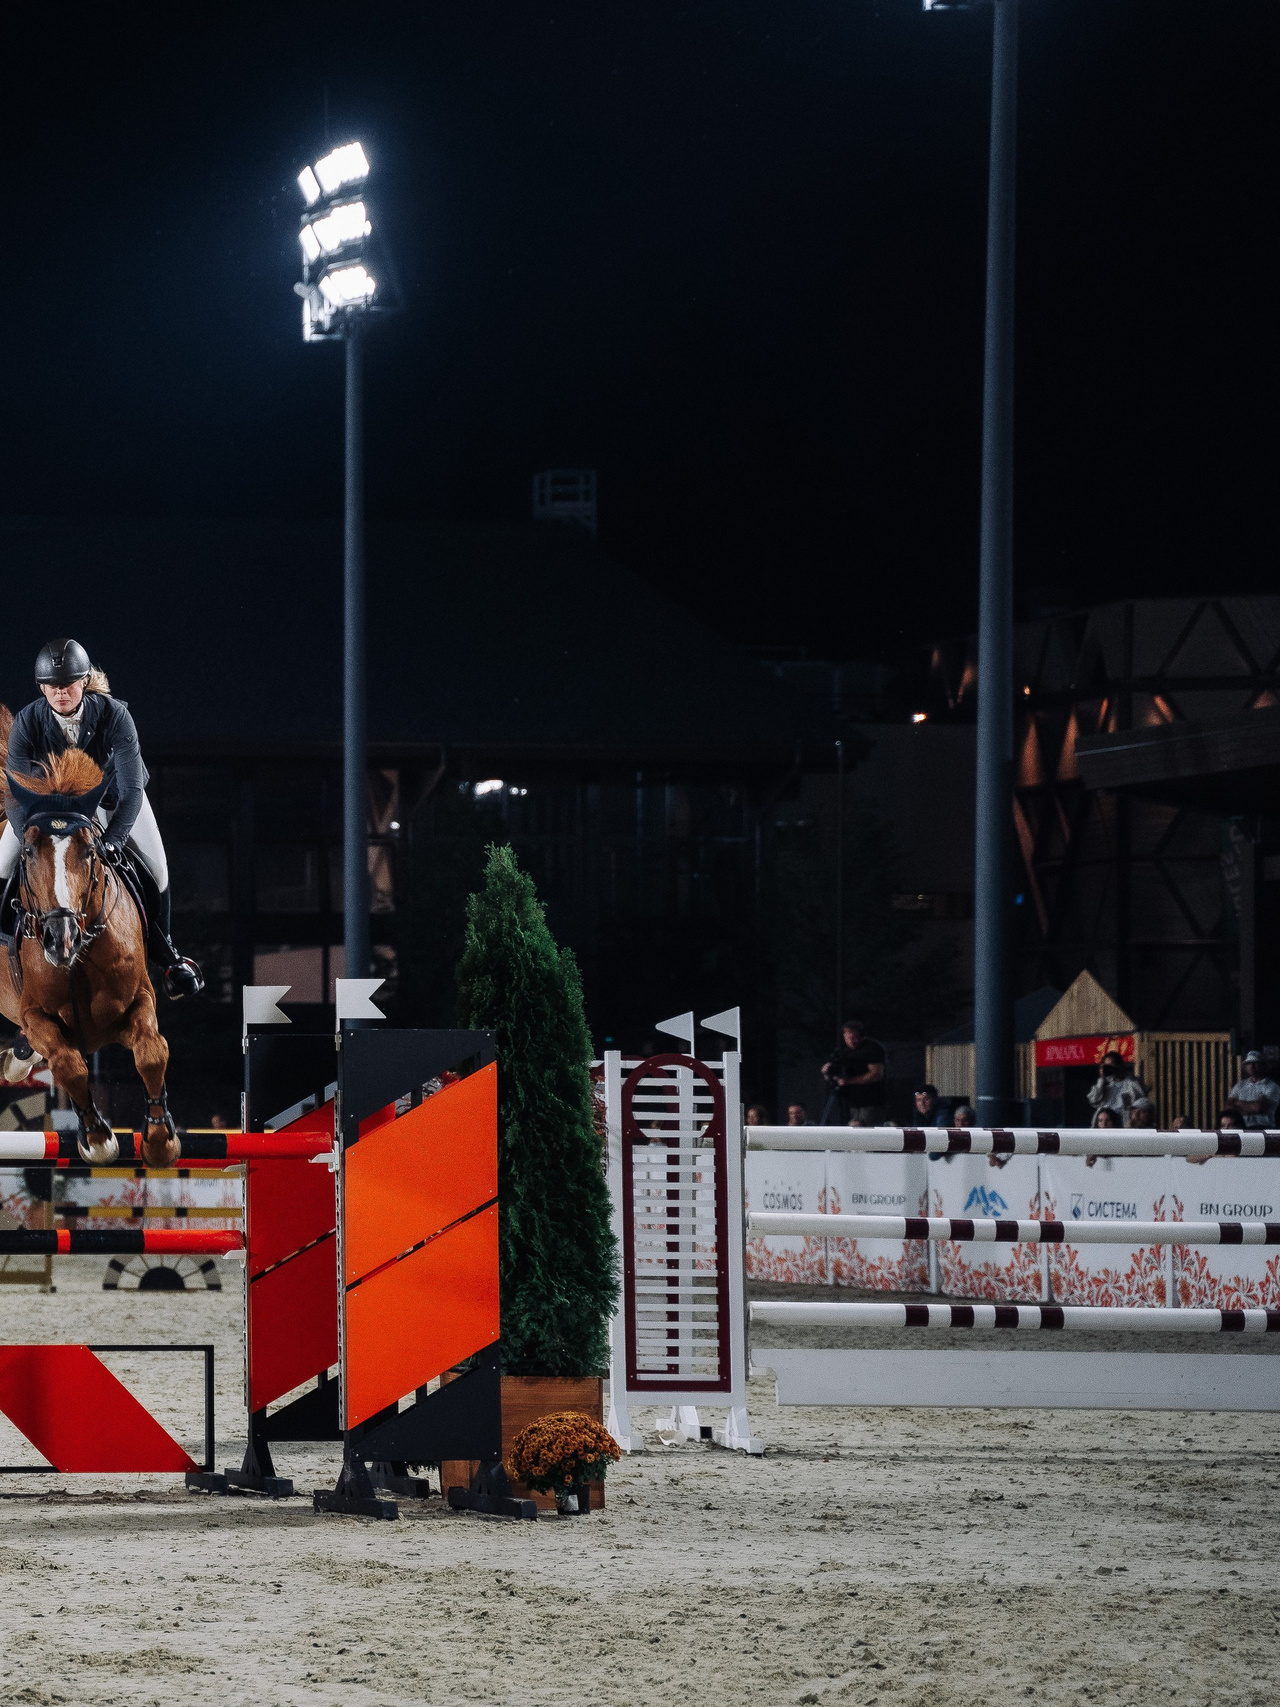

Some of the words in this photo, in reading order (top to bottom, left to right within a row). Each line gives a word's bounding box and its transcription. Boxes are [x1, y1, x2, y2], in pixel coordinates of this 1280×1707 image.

[763, 1193, 803, 1211] COSMOS
[851, 1193, 867, 1205] BN
[869, 1193, 907, 1206] GROUP
[1087, 1200, 1138, 1220] СИСТЕМА
[1200, 1203, 1220, 1216] BN
[1222, 1203, 1273, 1218] GROUP
